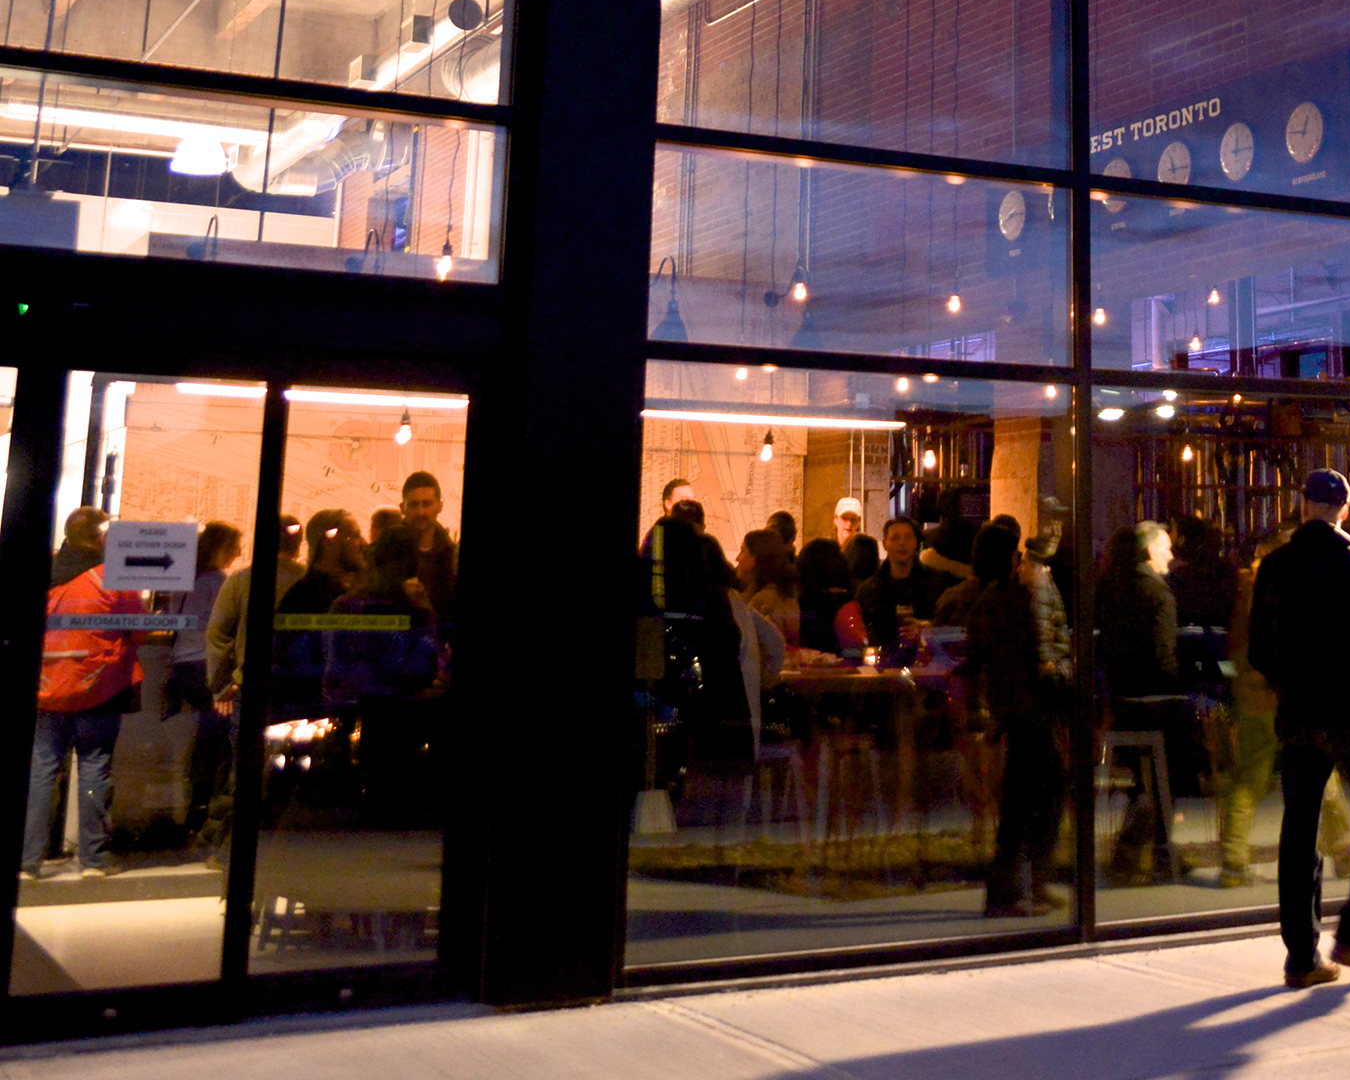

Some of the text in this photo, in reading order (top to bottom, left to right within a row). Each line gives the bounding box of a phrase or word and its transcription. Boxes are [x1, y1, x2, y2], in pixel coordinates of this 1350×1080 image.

[1090, 97, 1221, 154] EST TORONTO
[69, 616, 179, 627] AUTOMATIC DOOR
